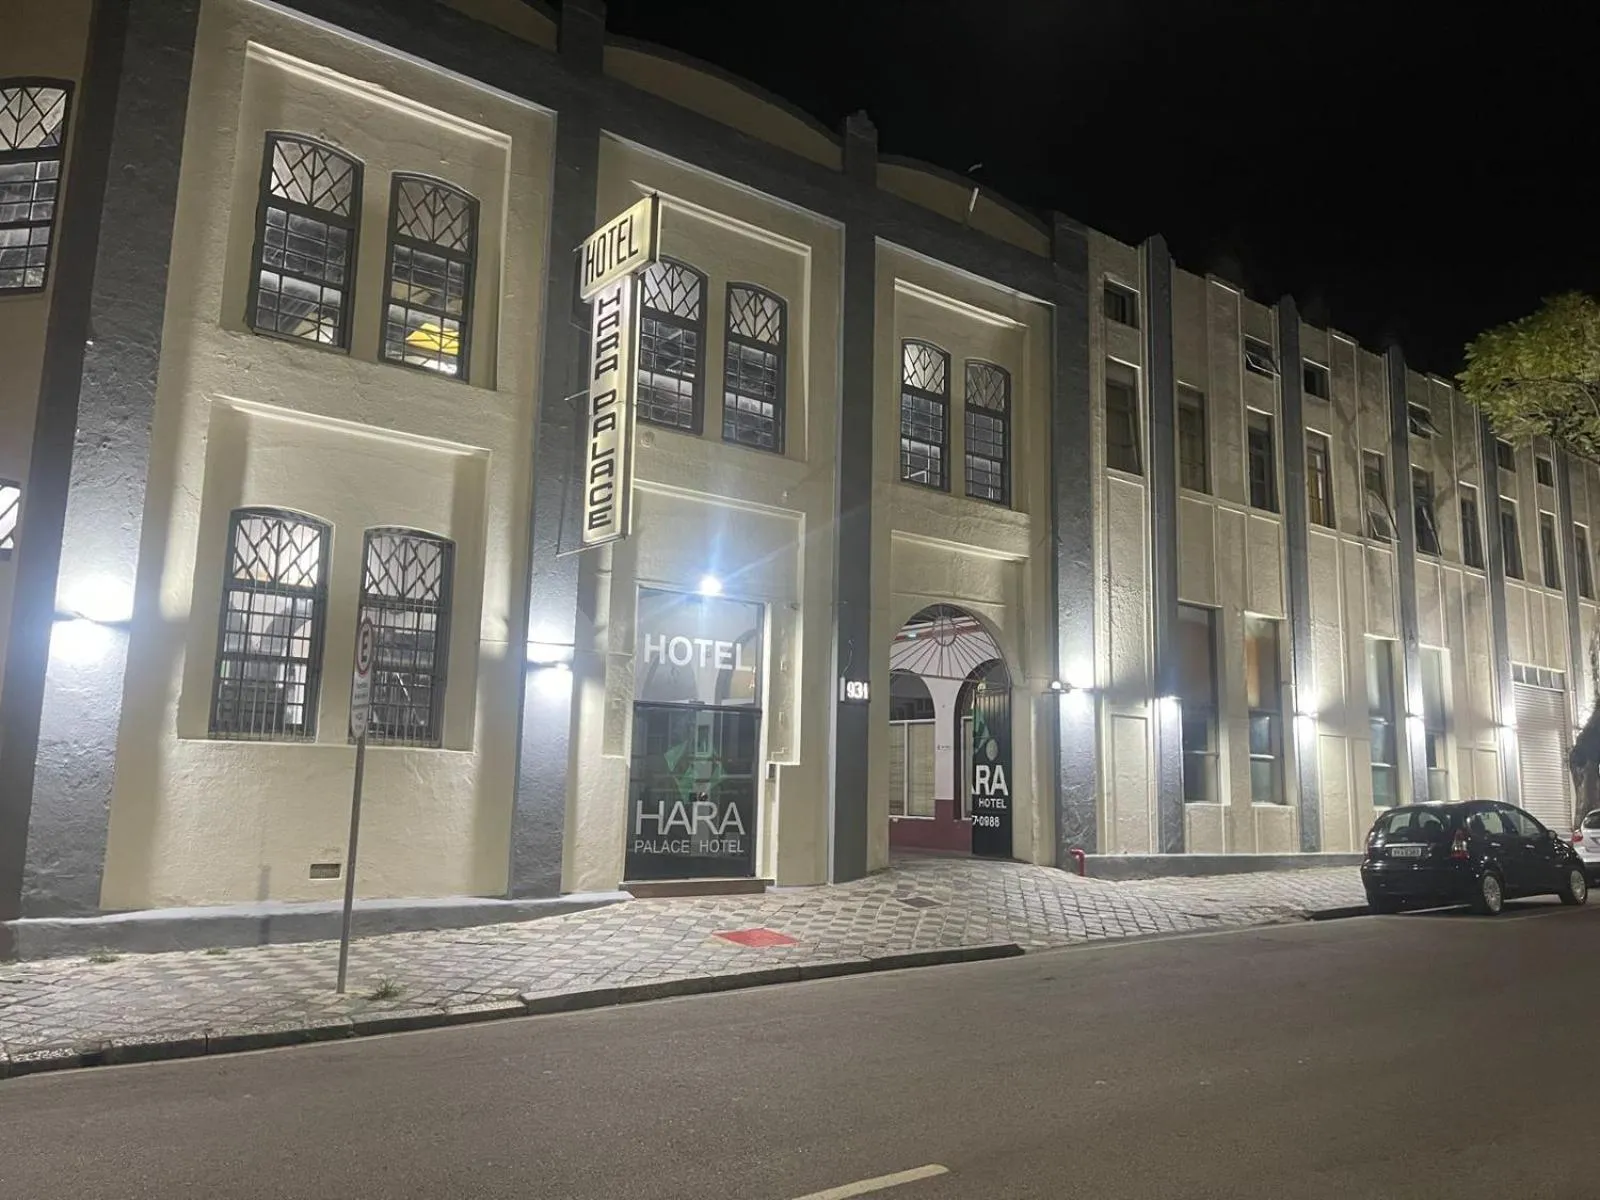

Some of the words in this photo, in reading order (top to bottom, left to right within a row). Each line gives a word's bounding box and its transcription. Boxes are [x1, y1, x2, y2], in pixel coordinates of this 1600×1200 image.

[585, 214, 638, 286] HOTEL
[595, 287, 621, 380] HARA
[588, 388, 617, 530] PALACE
[644, 633, 753, 671] HOTEL
[847, 681, 868, 699] 931
[971, 764, 1009, 796] RA
[635, 800, 745, 835] HARA
[978, 798, 1007, 809] HOTEL
[634, 839, 690, 854] PALACE
[699, 839, 744, 854] HOTEL
